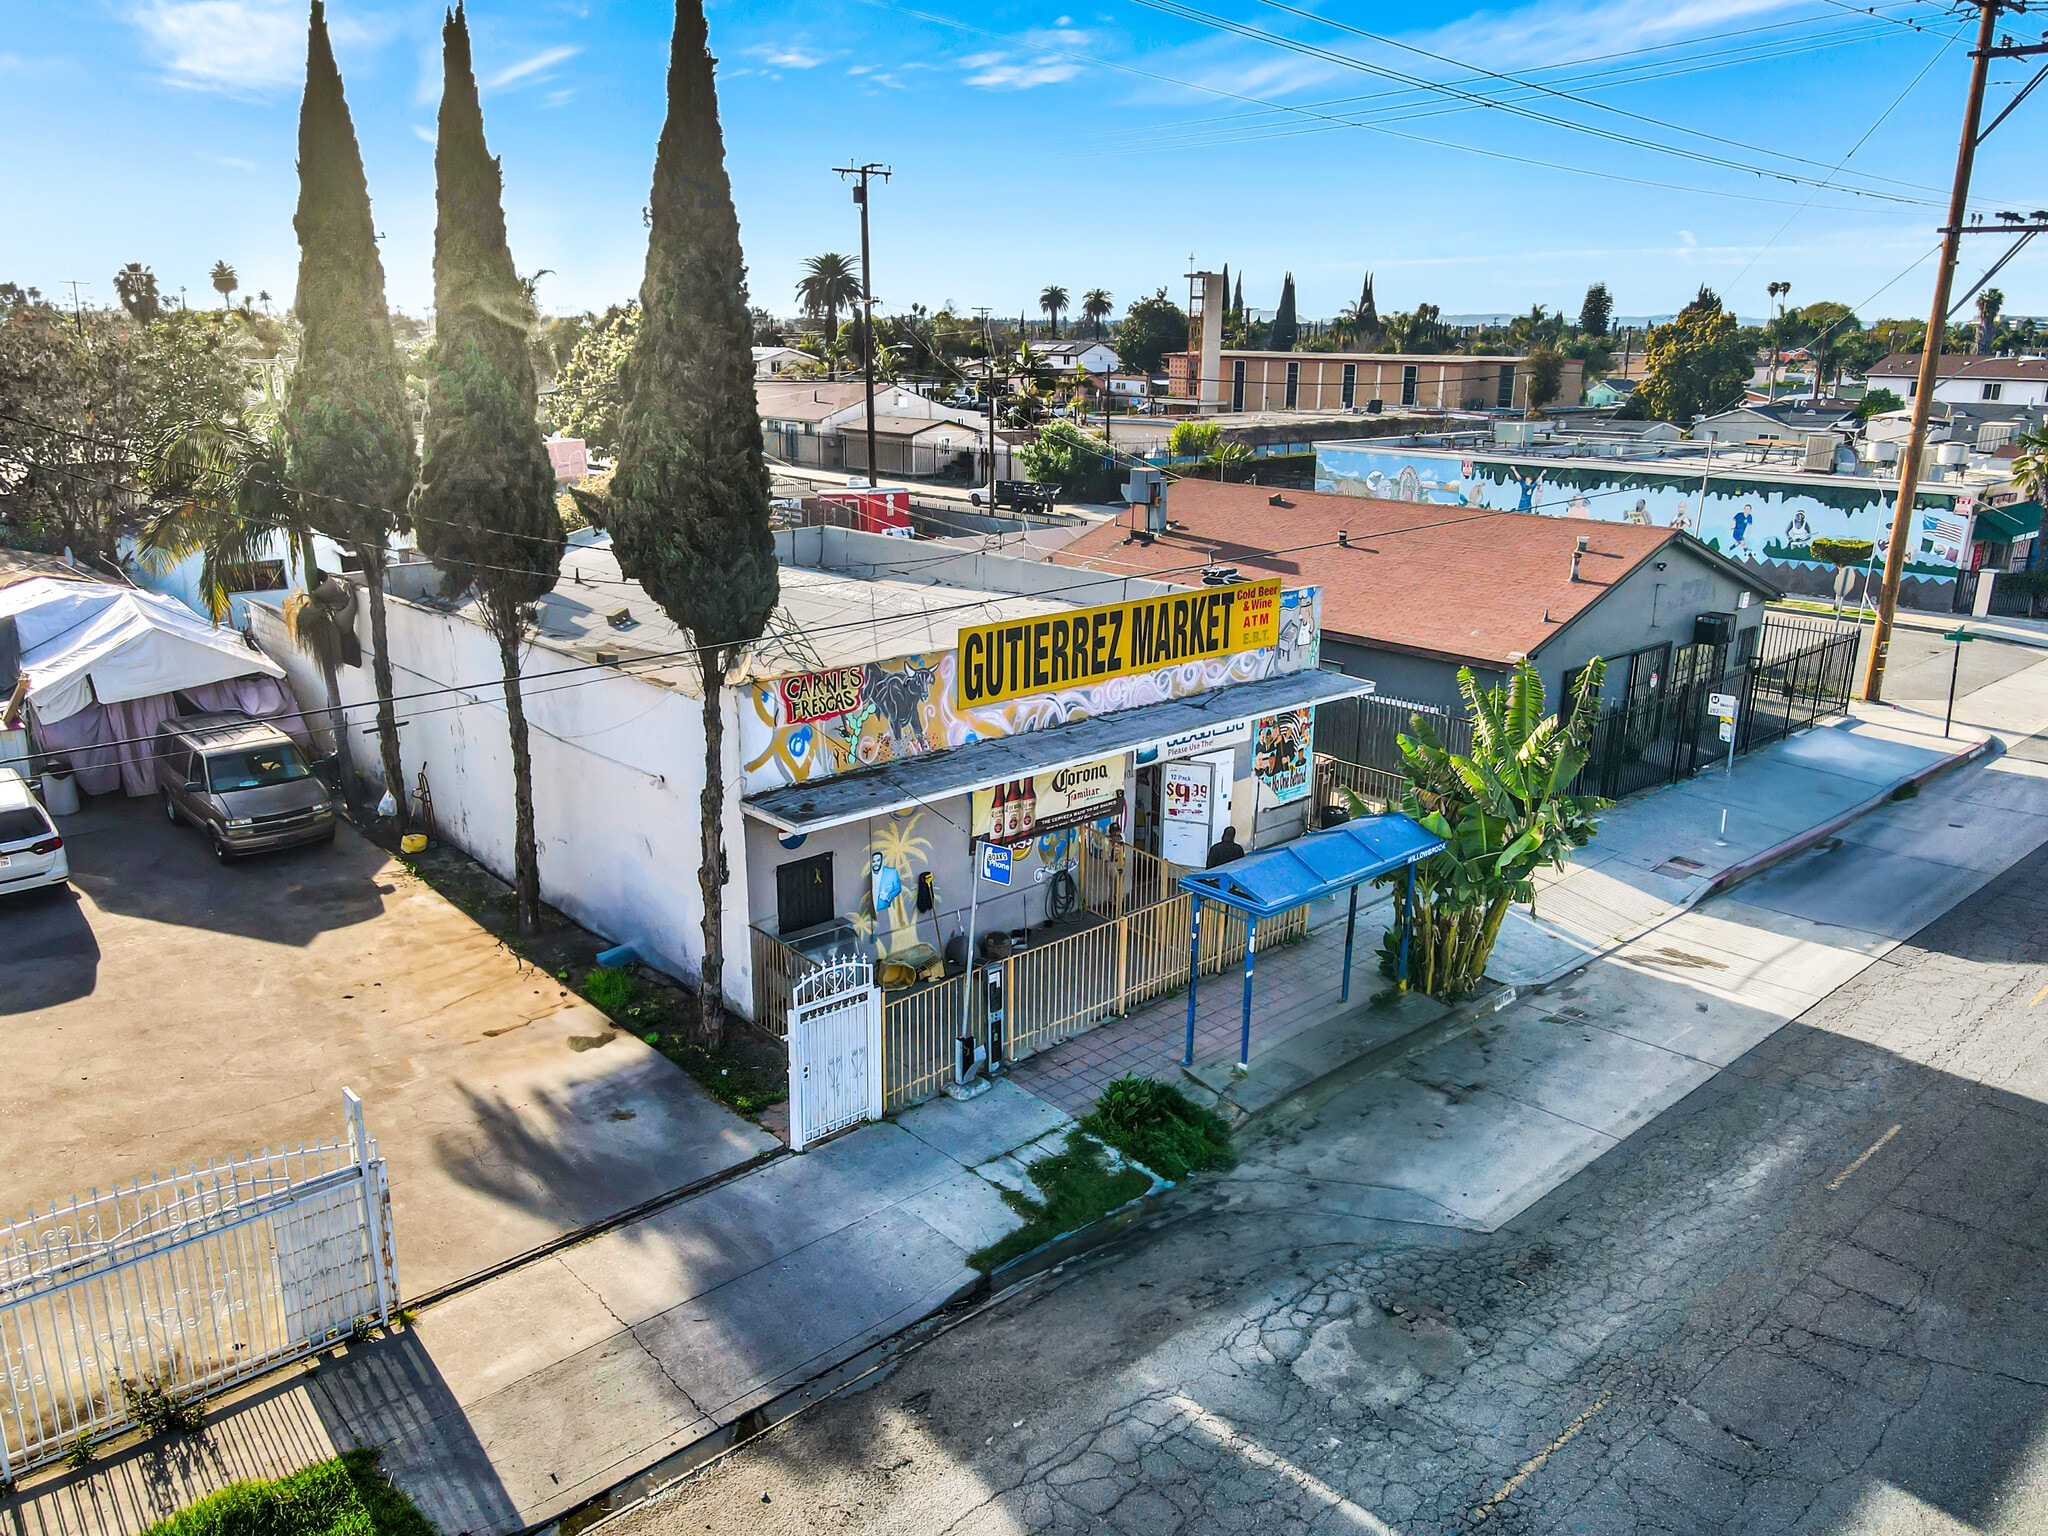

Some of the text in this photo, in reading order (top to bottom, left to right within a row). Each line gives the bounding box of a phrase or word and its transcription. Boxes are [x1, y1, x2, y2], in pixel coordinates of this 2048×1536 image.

[1237, 586, 1278, 600] Cold Beer
[1243, 599, 1272, 612] & Wine
[1243, 613, 1269, 628] ATM
[965, 592, 1235, 701] GUTIERREZ MARKET
[1243, 630, 1269, 645] E.B.T.
[786, 668, 862, 699] CARNES
[791, 690, 855, 720] FRESCAS
[1168, 747, 1188, 756] Please
[1189, 743, 1200, 751] Use
[1052, 764, 1108, 793] Corona
[1066, 787, 1100, 808] Familiar
[1052, 813, 1073, 823] CERVEZA
[1100, 800, 1117, 808] SHARED
[1407, 842, 1446, 864] WILLOWBROOK
[989, 860, 1010, 871] Phone
